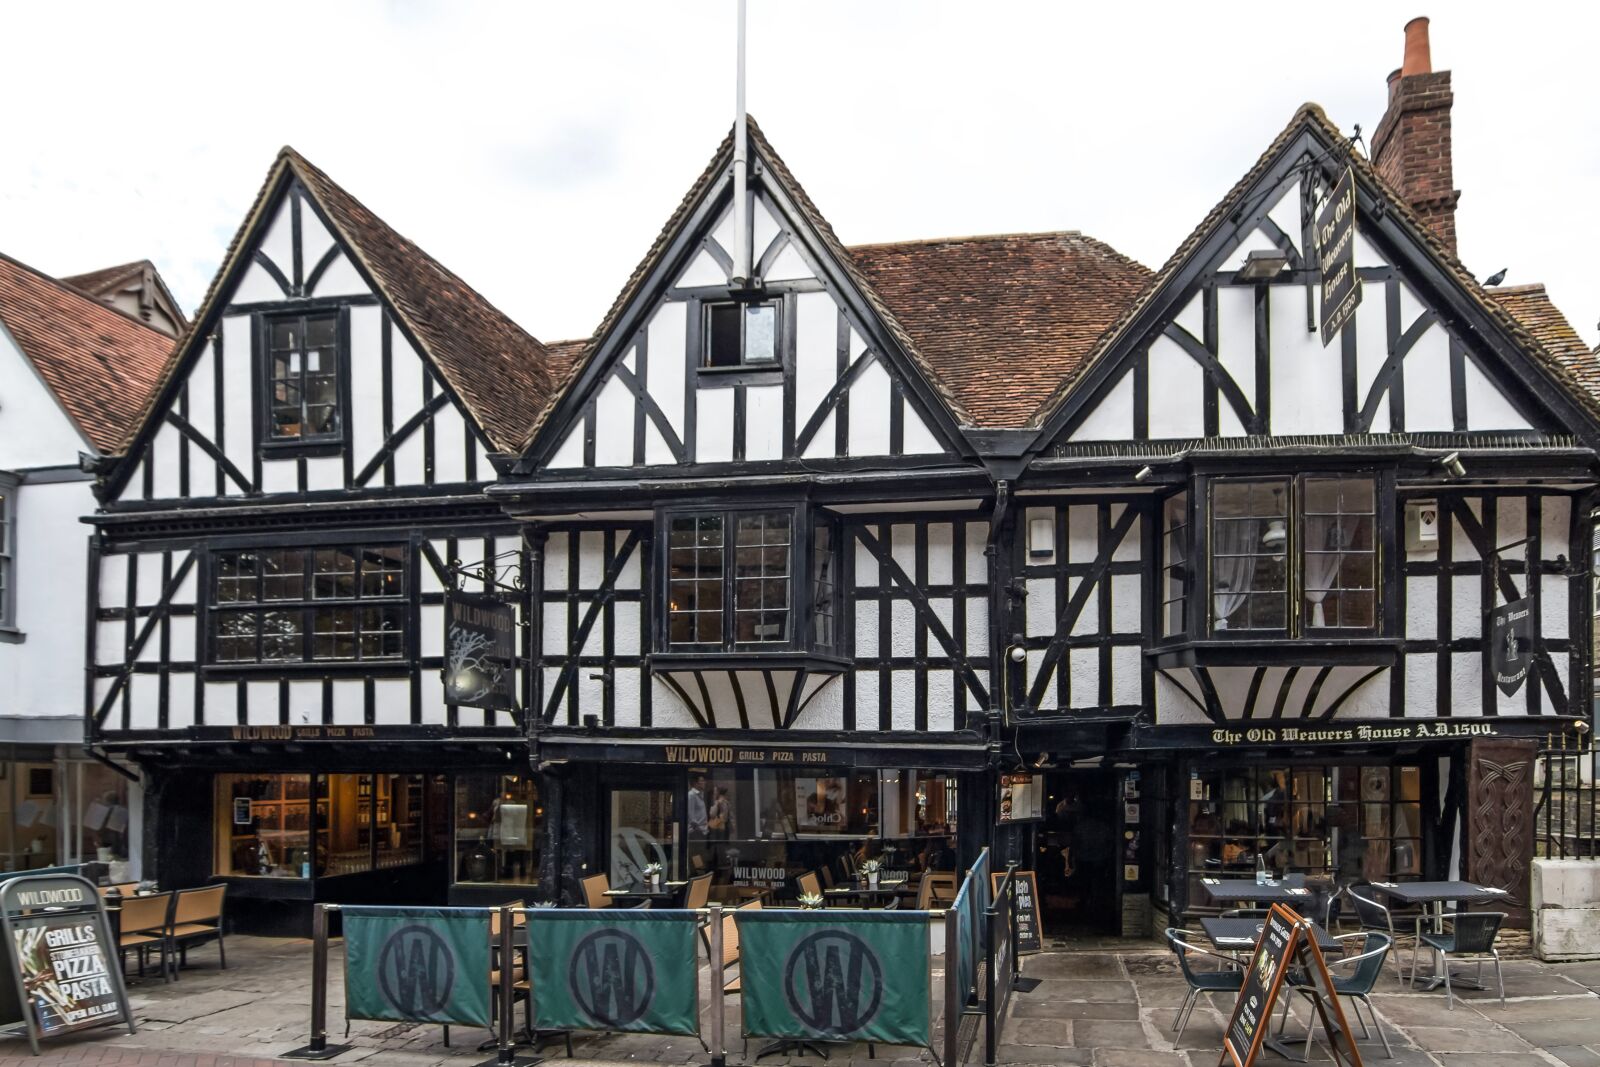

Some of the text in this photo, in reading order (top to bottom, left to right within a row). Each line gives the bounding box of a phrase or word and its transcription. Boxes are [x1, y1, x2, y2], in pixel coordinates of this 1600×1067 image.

[1321, 189, 1351, 245] The Old
[1321, 224, 1353, 275] Weavers
[1324, 261, 1348, 305] House
[452, 601, 511, 632] WILDWOOD
[232, 726, 293, 740] WILDWOOD
[327, 727, 346, 737] PIZZA
[352, 727, 374, 737] PASTA
[1212, 729, 1242, 744] The
[1246, 728, 1276, 742] Old
[1281, 728, 1353, 741] Weavers
[1357, 725, 1411, 741] House
[665, 747, 826, 763] WILDWOOD GRILLS PIZZA PASTA
[733, 867, 785, 880] WILDWOOD
[17, 888, 83, 905] WILDWOOD
[45, 925, 96, 948] GRILLS
[53, 955, 105, 980] PIZZA
[60, 977, 112, 1001] PASTA
[68, 1002, 118, 1021] OPEN ALL DAY
